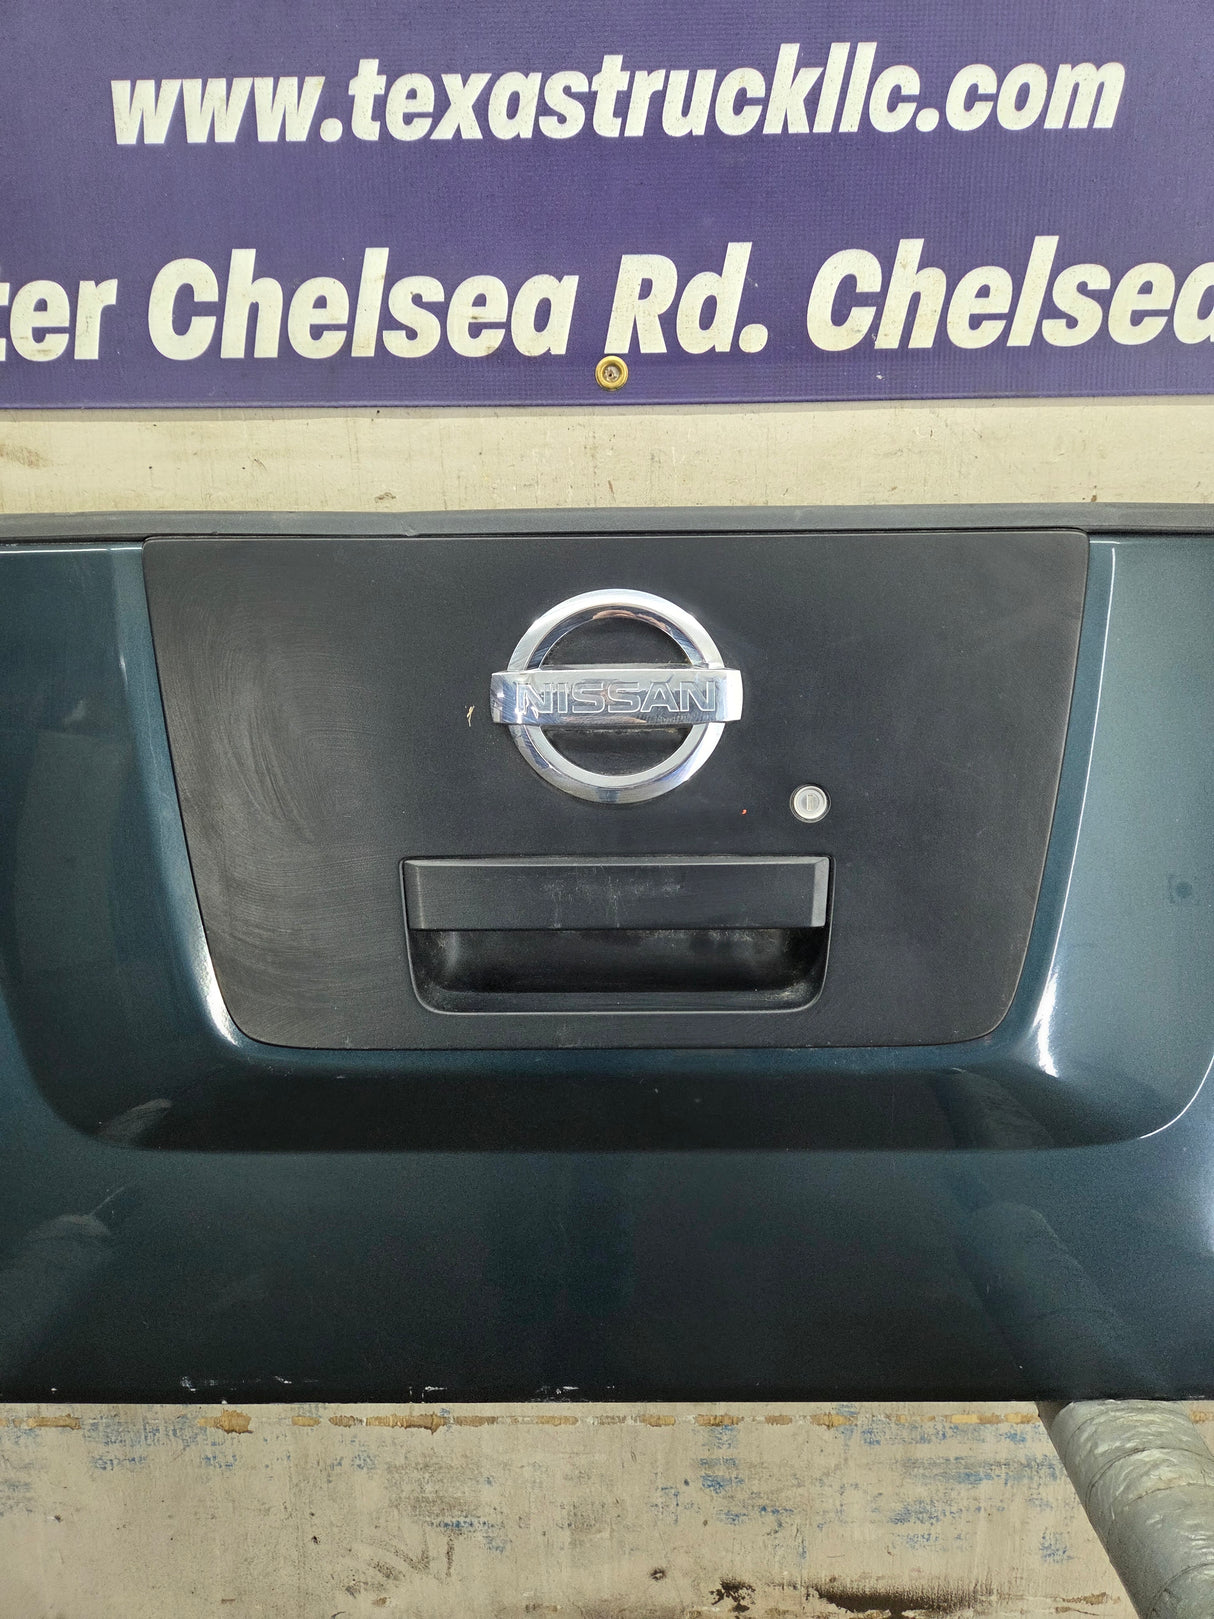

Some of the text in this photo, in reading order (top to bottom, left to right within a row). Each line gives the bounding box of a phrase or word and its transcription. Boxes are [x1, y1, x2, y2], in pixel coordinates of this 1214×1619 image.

[110, 41, 1126, 146] www.texastruckllc.com
[0, 235, 1214, 362] er Chelsea Rd. Chelsea
[514, 680, 718, 715] NISSAN
